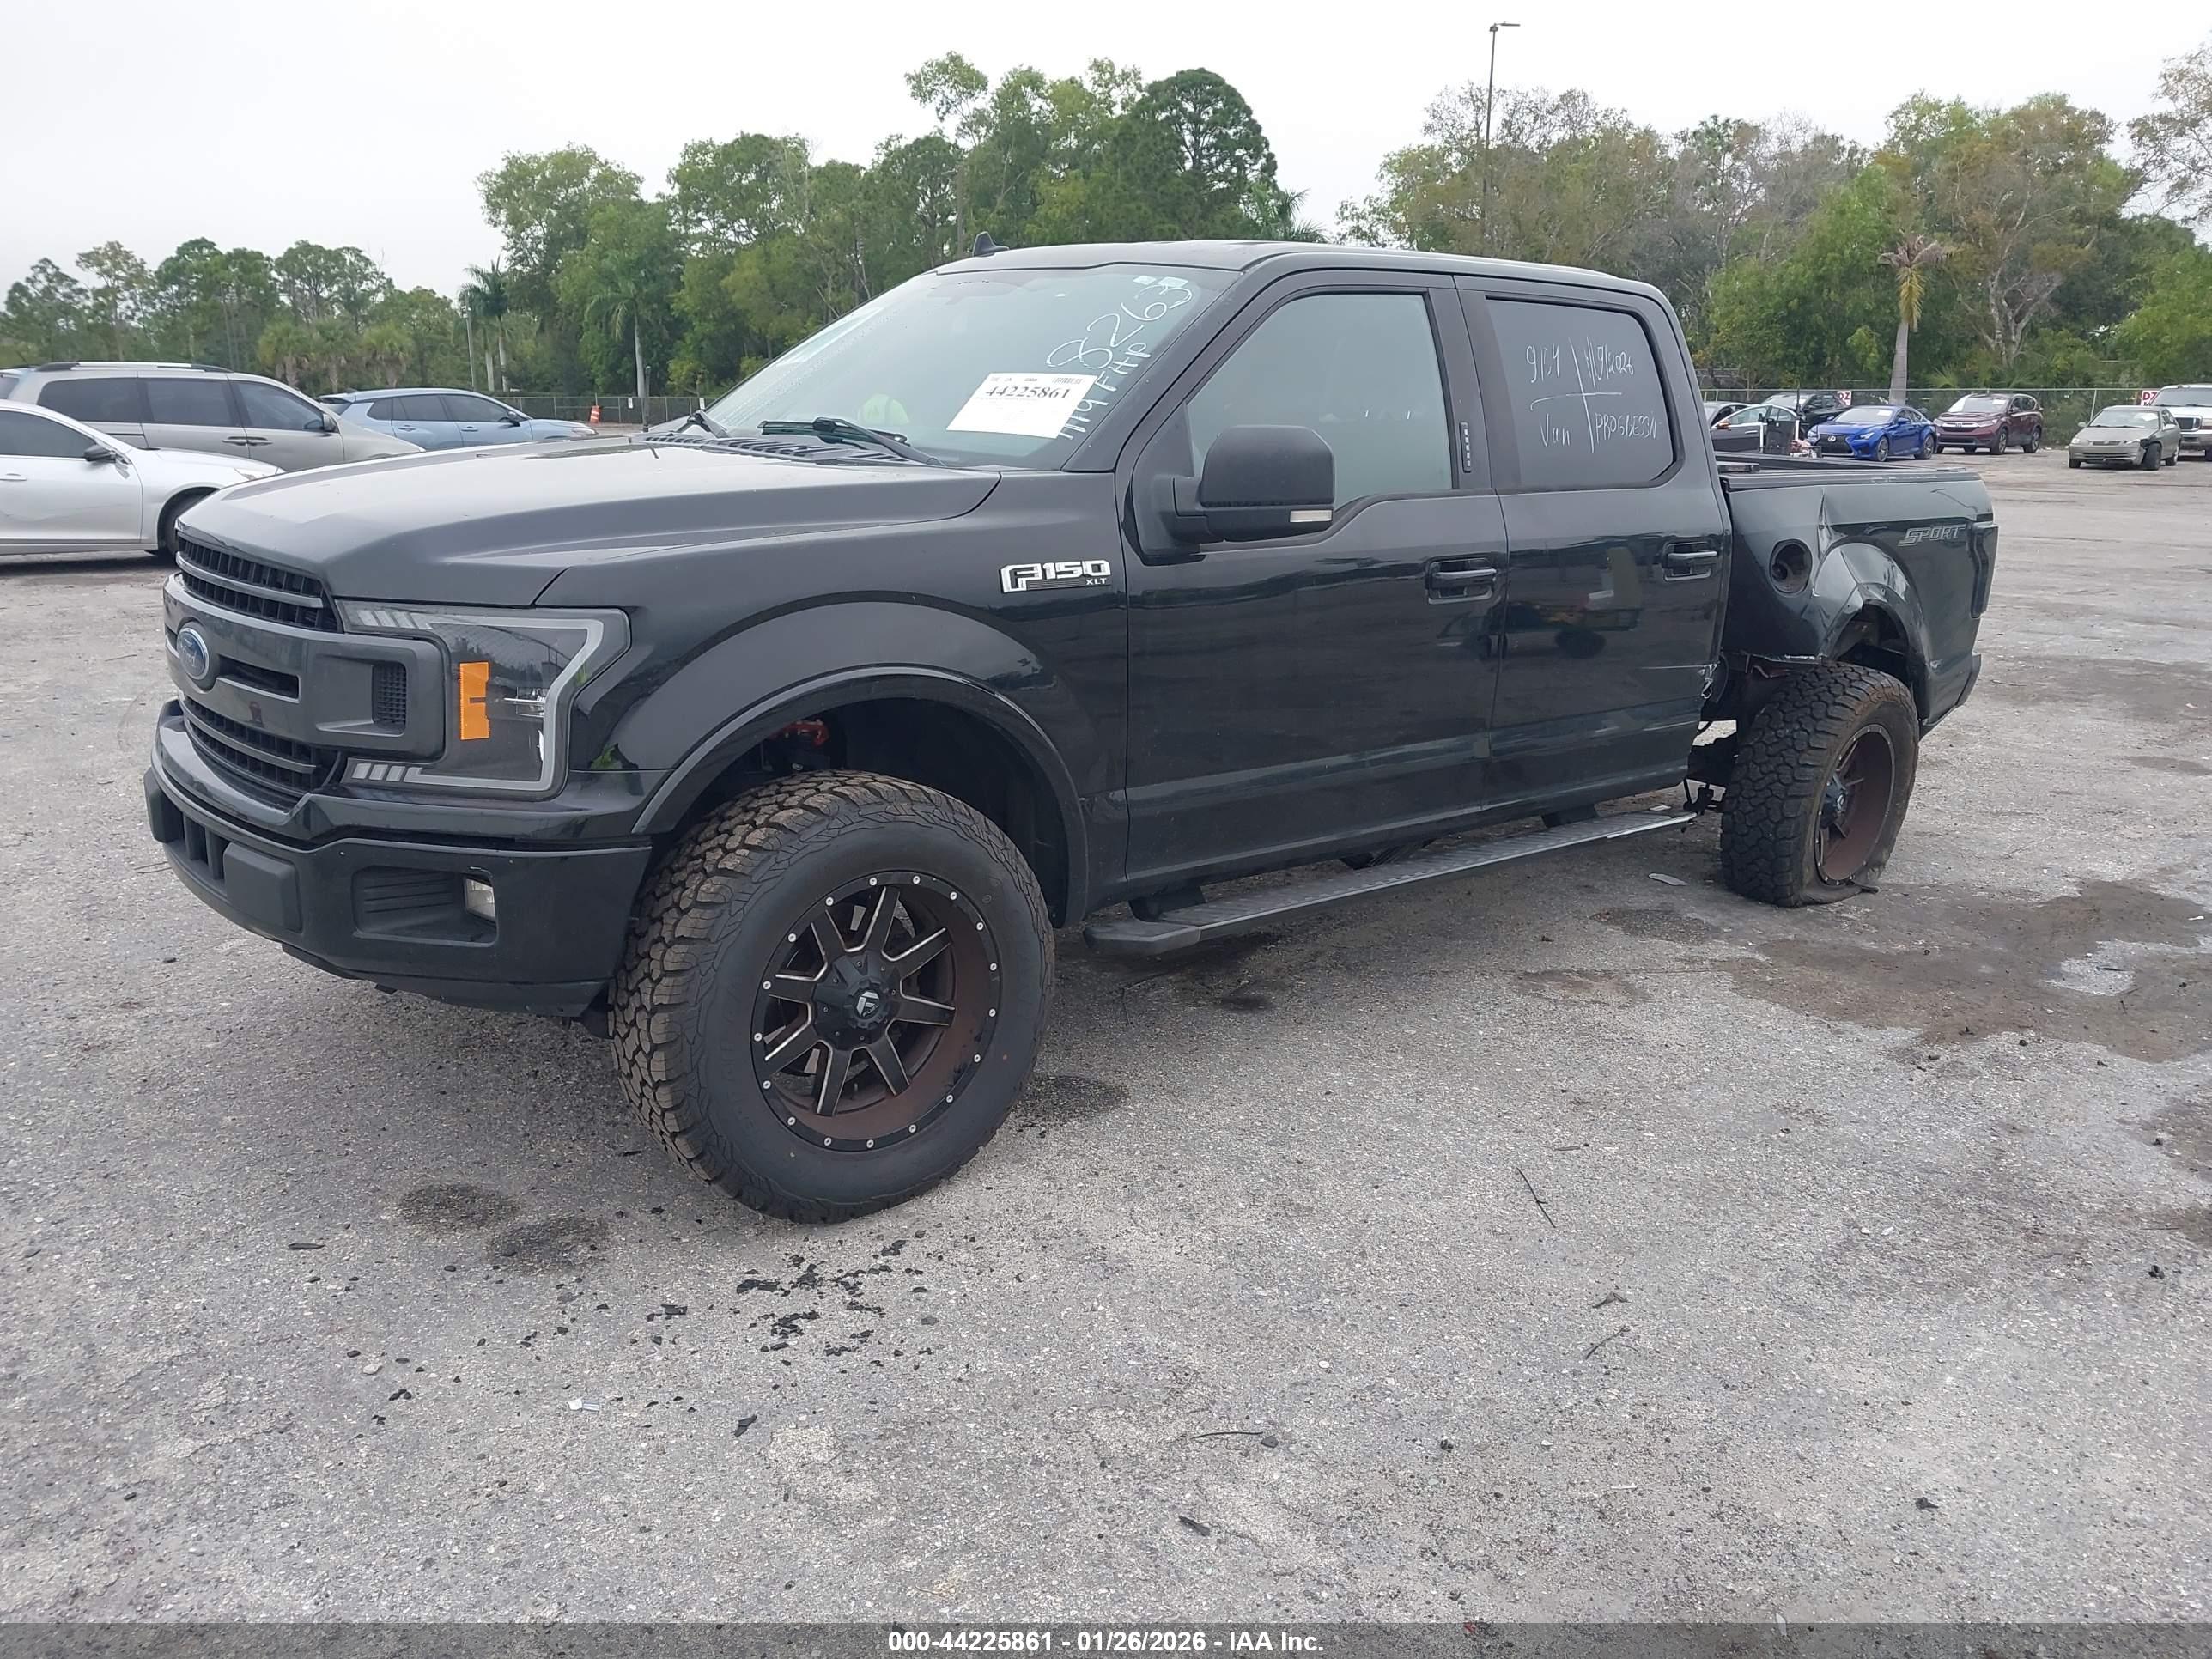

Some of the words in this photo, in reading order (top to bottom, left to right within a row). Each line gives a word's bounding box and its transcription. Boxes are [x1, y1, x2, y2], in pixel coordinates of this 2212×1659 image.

[985, 385, 1071, 399] 44225861
[1897, 523, 1967, 547] SPORT
[1085, 577, 1108, 586] XLT
